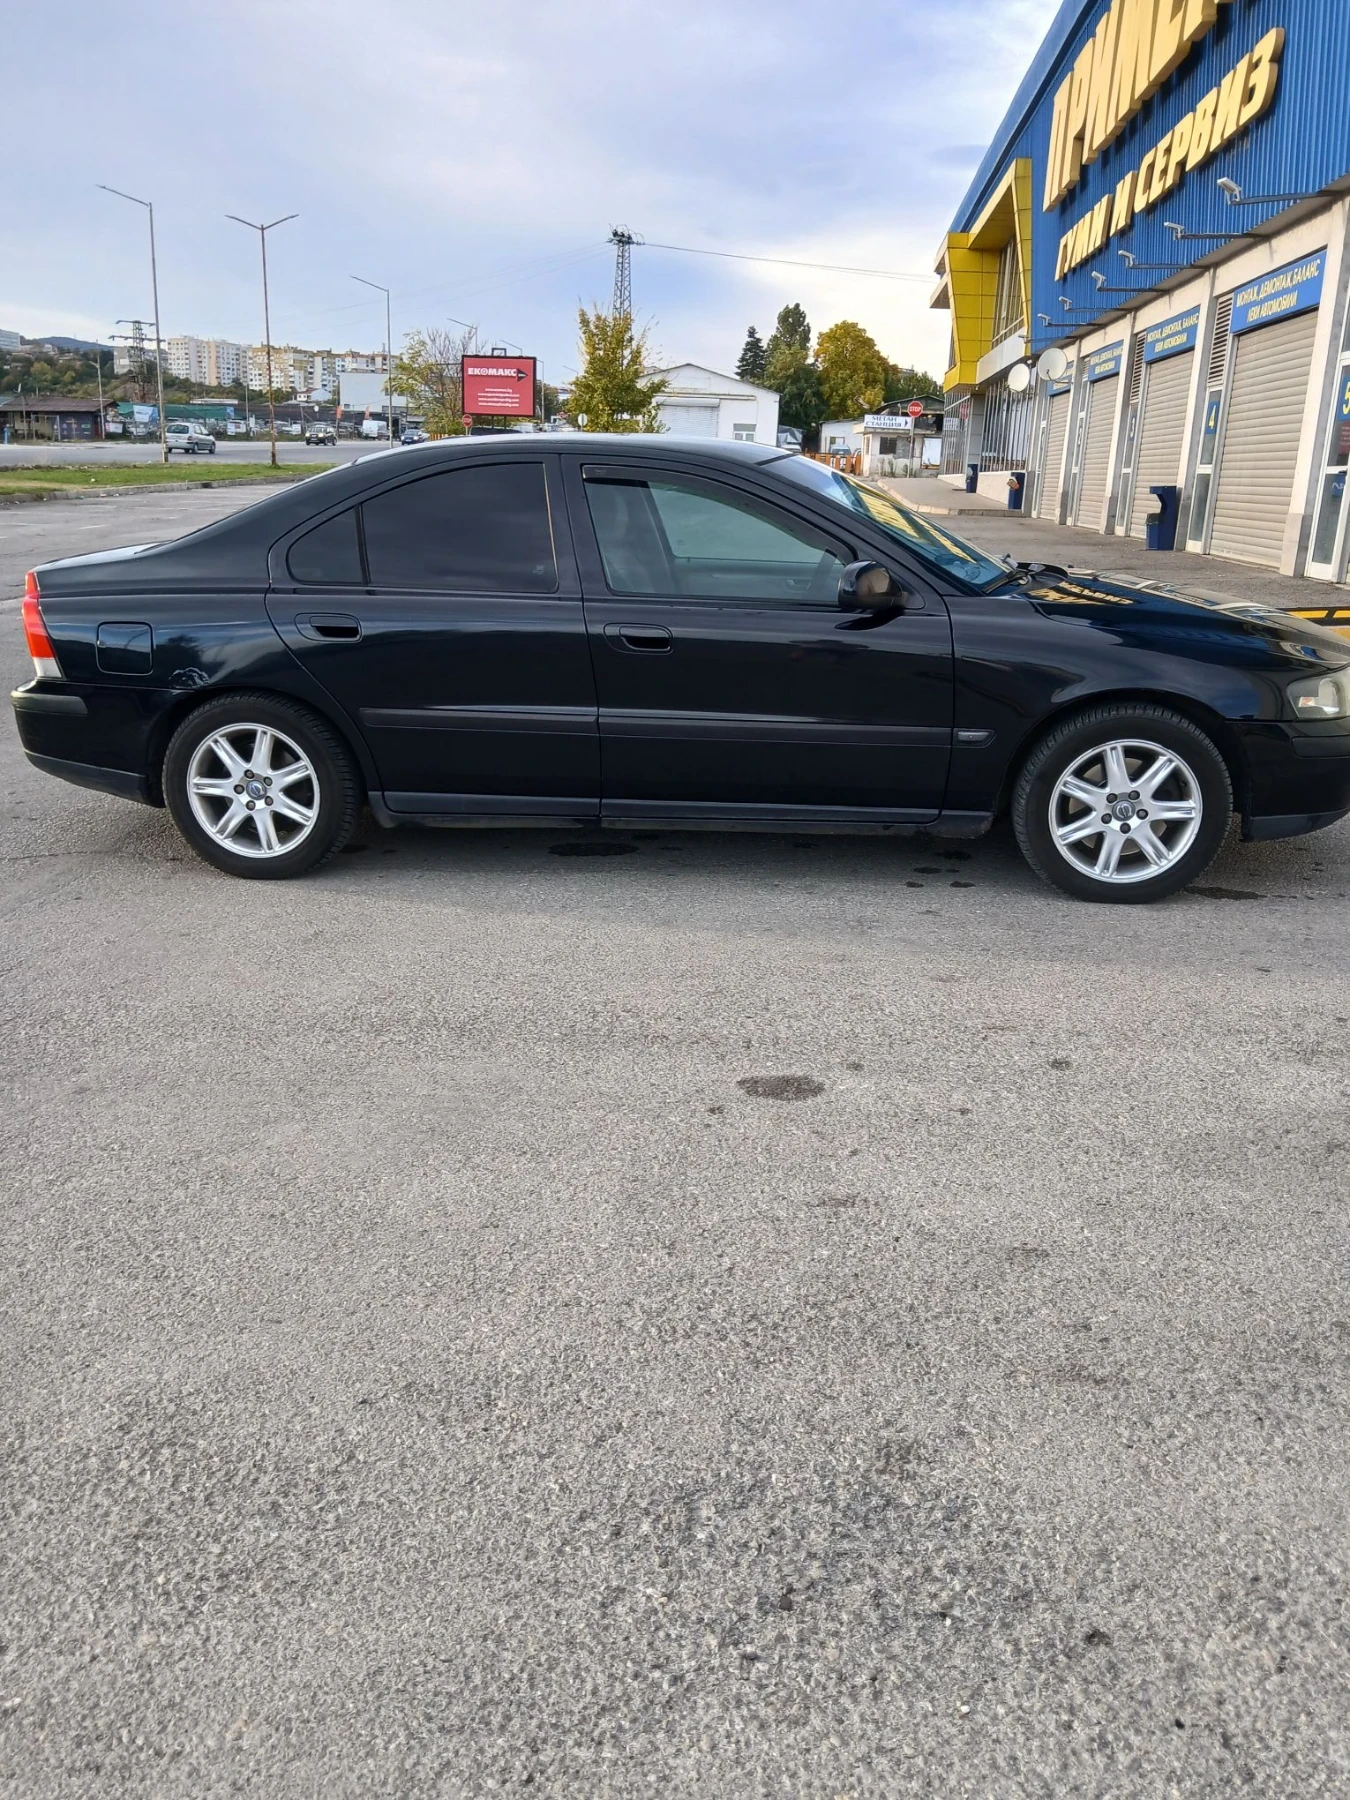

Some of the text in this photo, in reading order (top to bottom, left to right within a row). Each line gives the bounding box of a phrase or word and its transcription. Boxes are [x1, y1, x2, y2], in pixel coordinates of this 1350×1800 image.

[1054, 27, 1286, 282] ГУМИ И СЕРВИЗ
[467, 367, 517, 377] ЕКОМАКС
[1208, 404, 1217, 430] 4
